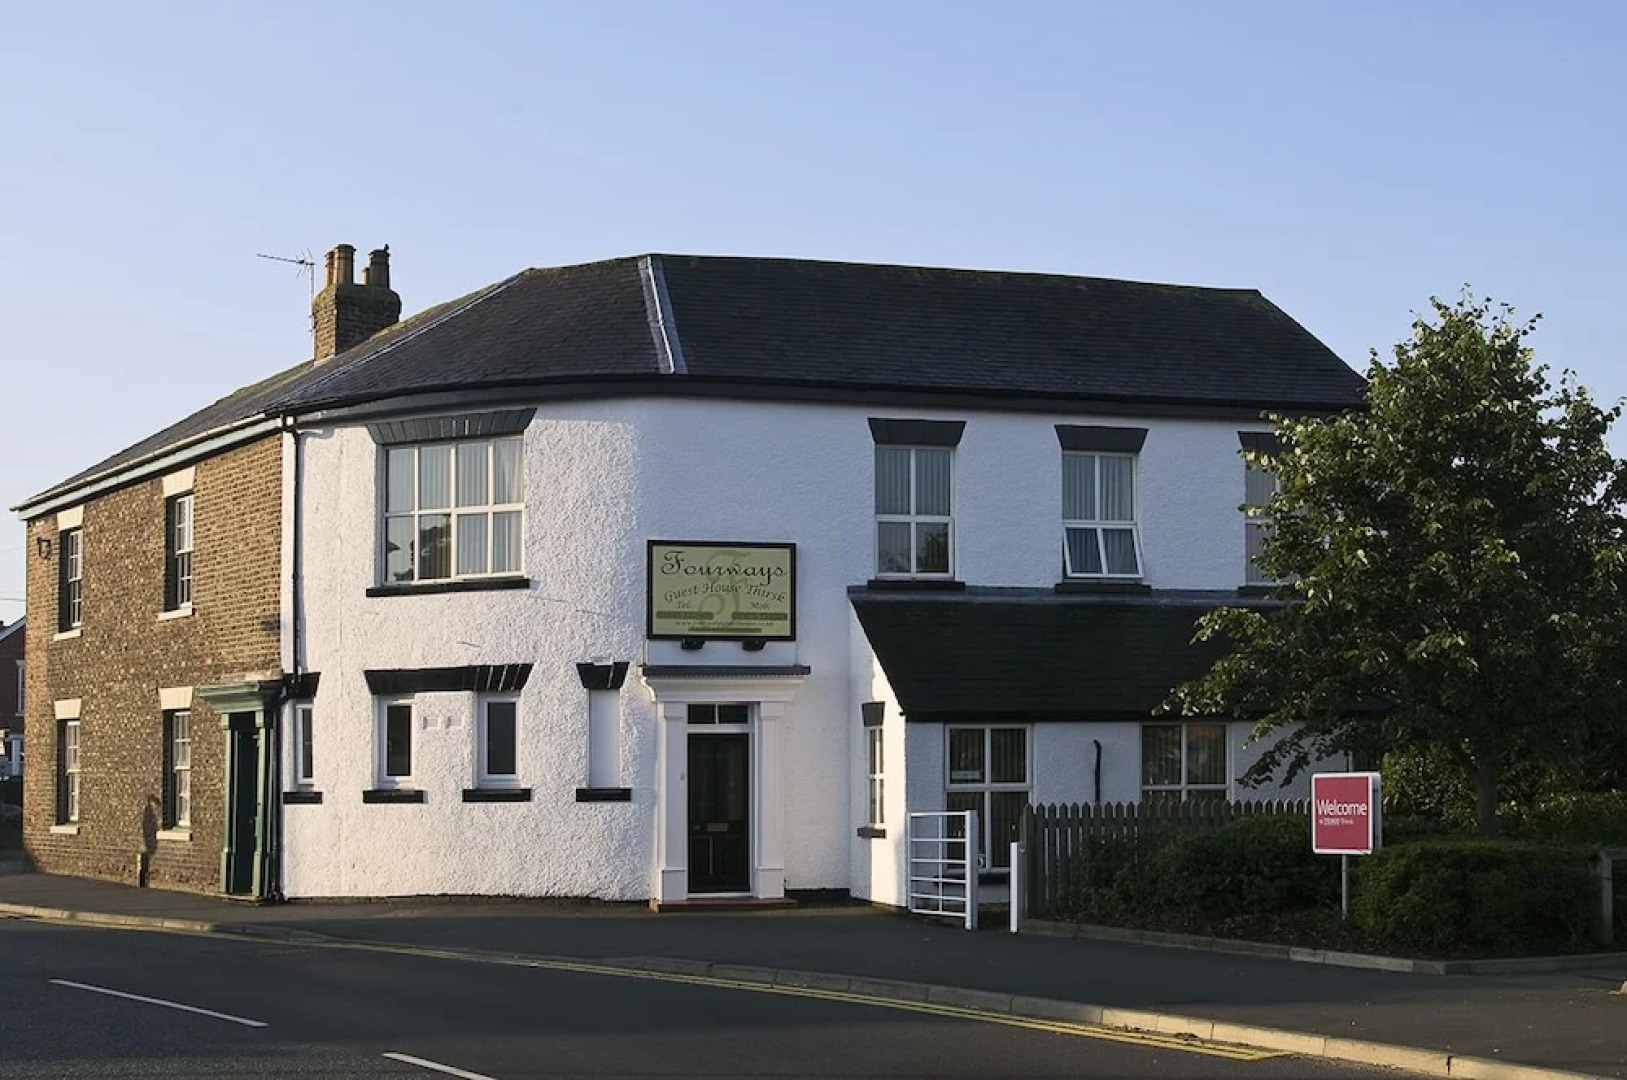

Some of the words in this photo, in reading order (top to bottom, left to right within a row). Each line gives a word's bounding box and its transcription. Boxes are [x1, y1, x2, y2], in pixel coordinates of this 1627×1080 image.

[660, 550, 787, 585] Fourways
[664, 584, 699, 603] Guest
[703, 580, 743, 595] House
[1316, 799, 1367, 816] Welcome
